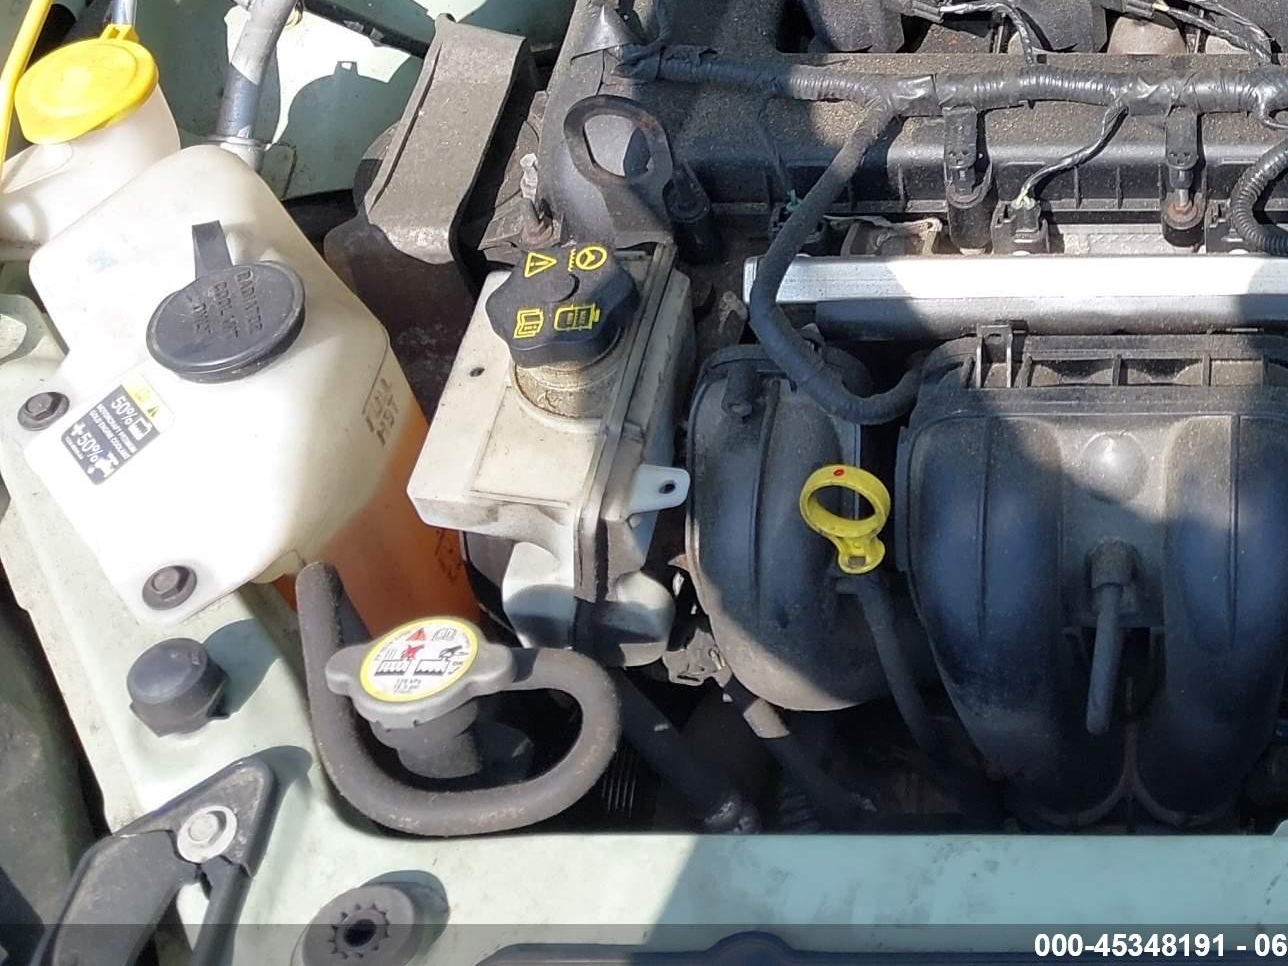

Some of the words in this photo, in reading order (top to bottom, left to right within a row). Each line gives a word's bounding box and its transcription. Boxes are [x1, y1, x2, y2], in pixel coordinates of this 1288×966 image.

[213, 281, 239, 338] COOLANT
[236, 270, 264, 333] RADIATOR
[109, 394, 139, 425] 50%
